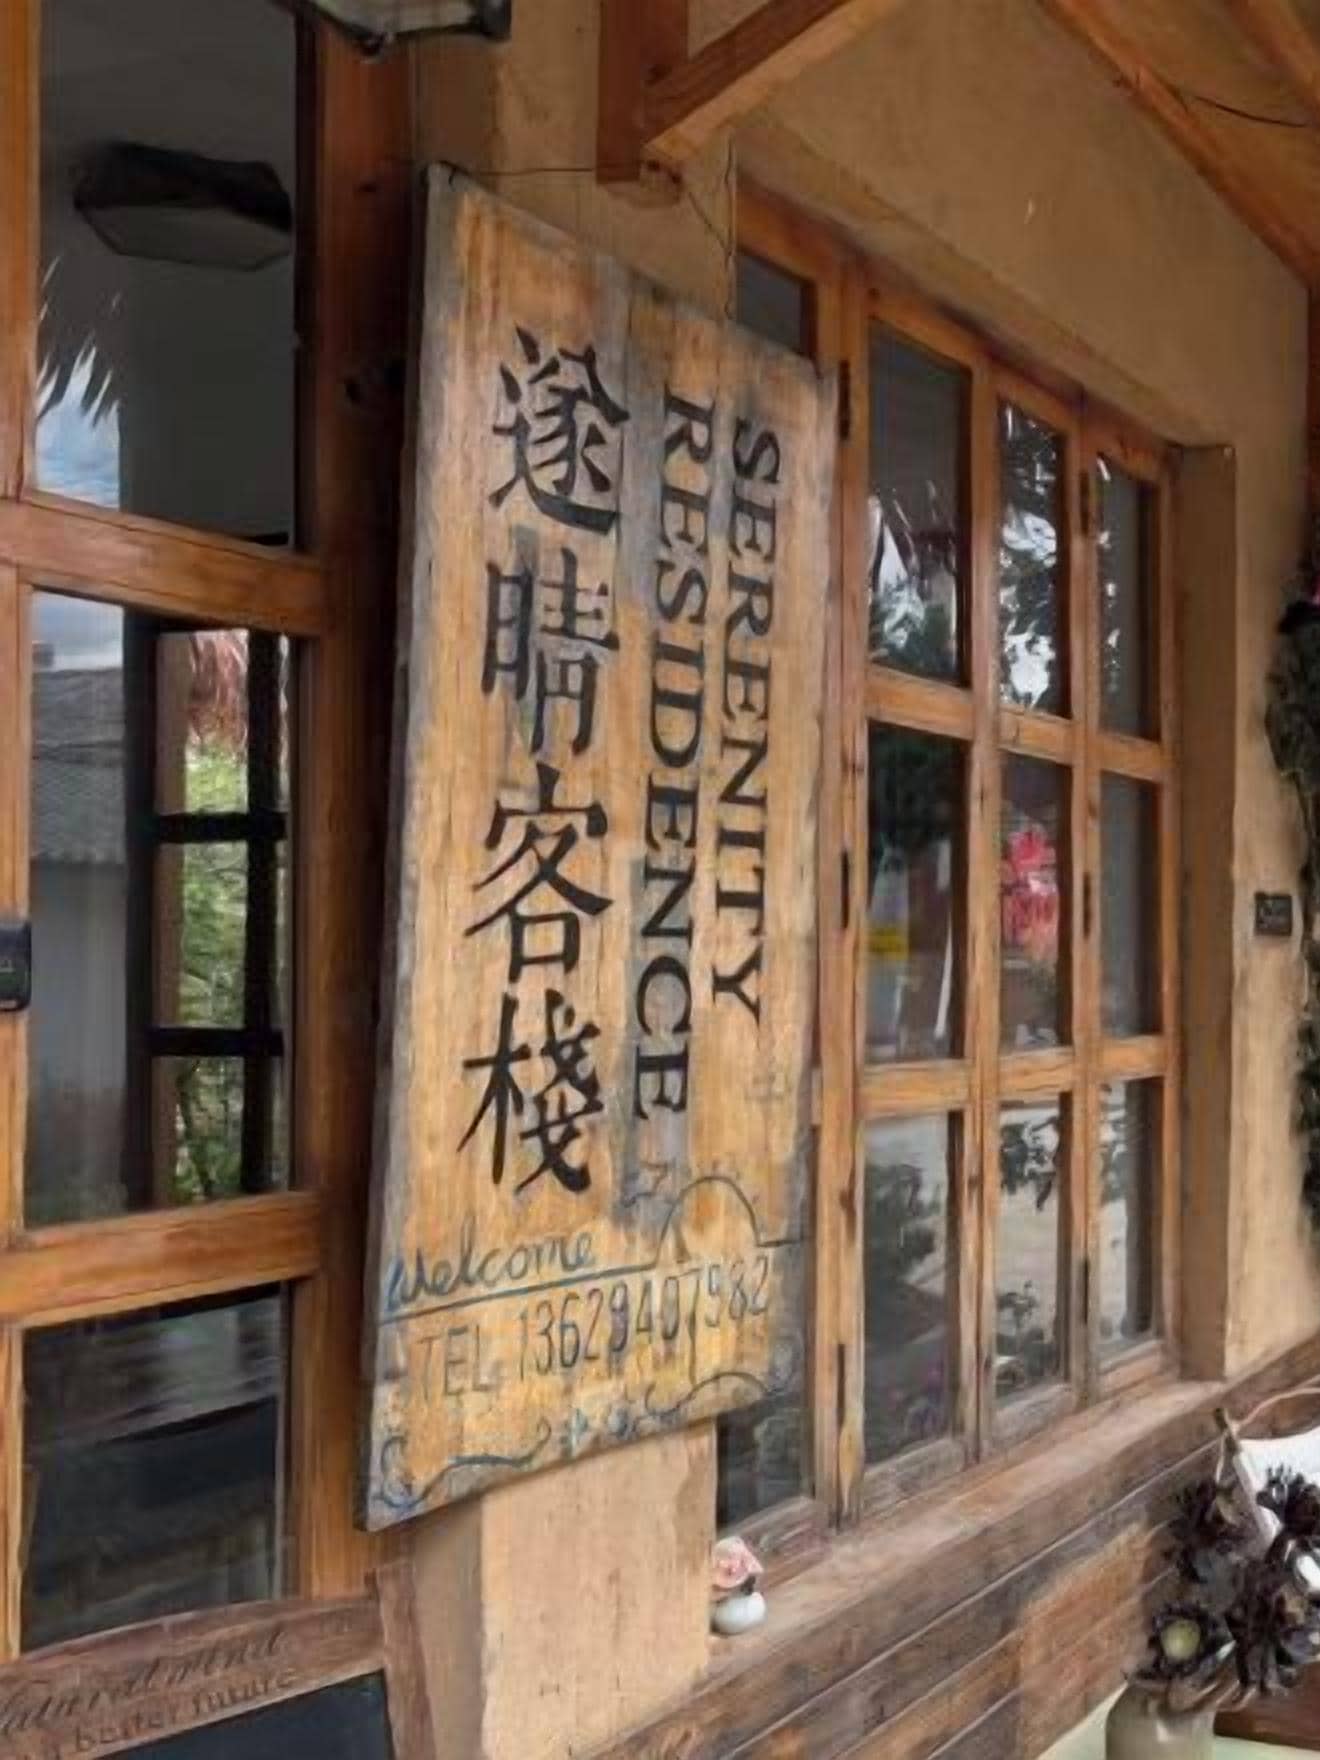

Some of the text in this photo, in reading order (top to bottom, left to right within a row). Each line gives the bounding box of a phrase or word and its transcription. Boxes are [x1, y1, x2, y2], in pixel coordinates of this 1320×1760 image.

[631, 383, 716, 1120] RESIDENCE
[710, 415, 782, 1025] SERENITY
[385, 1219, 598, 1312] Welcome
